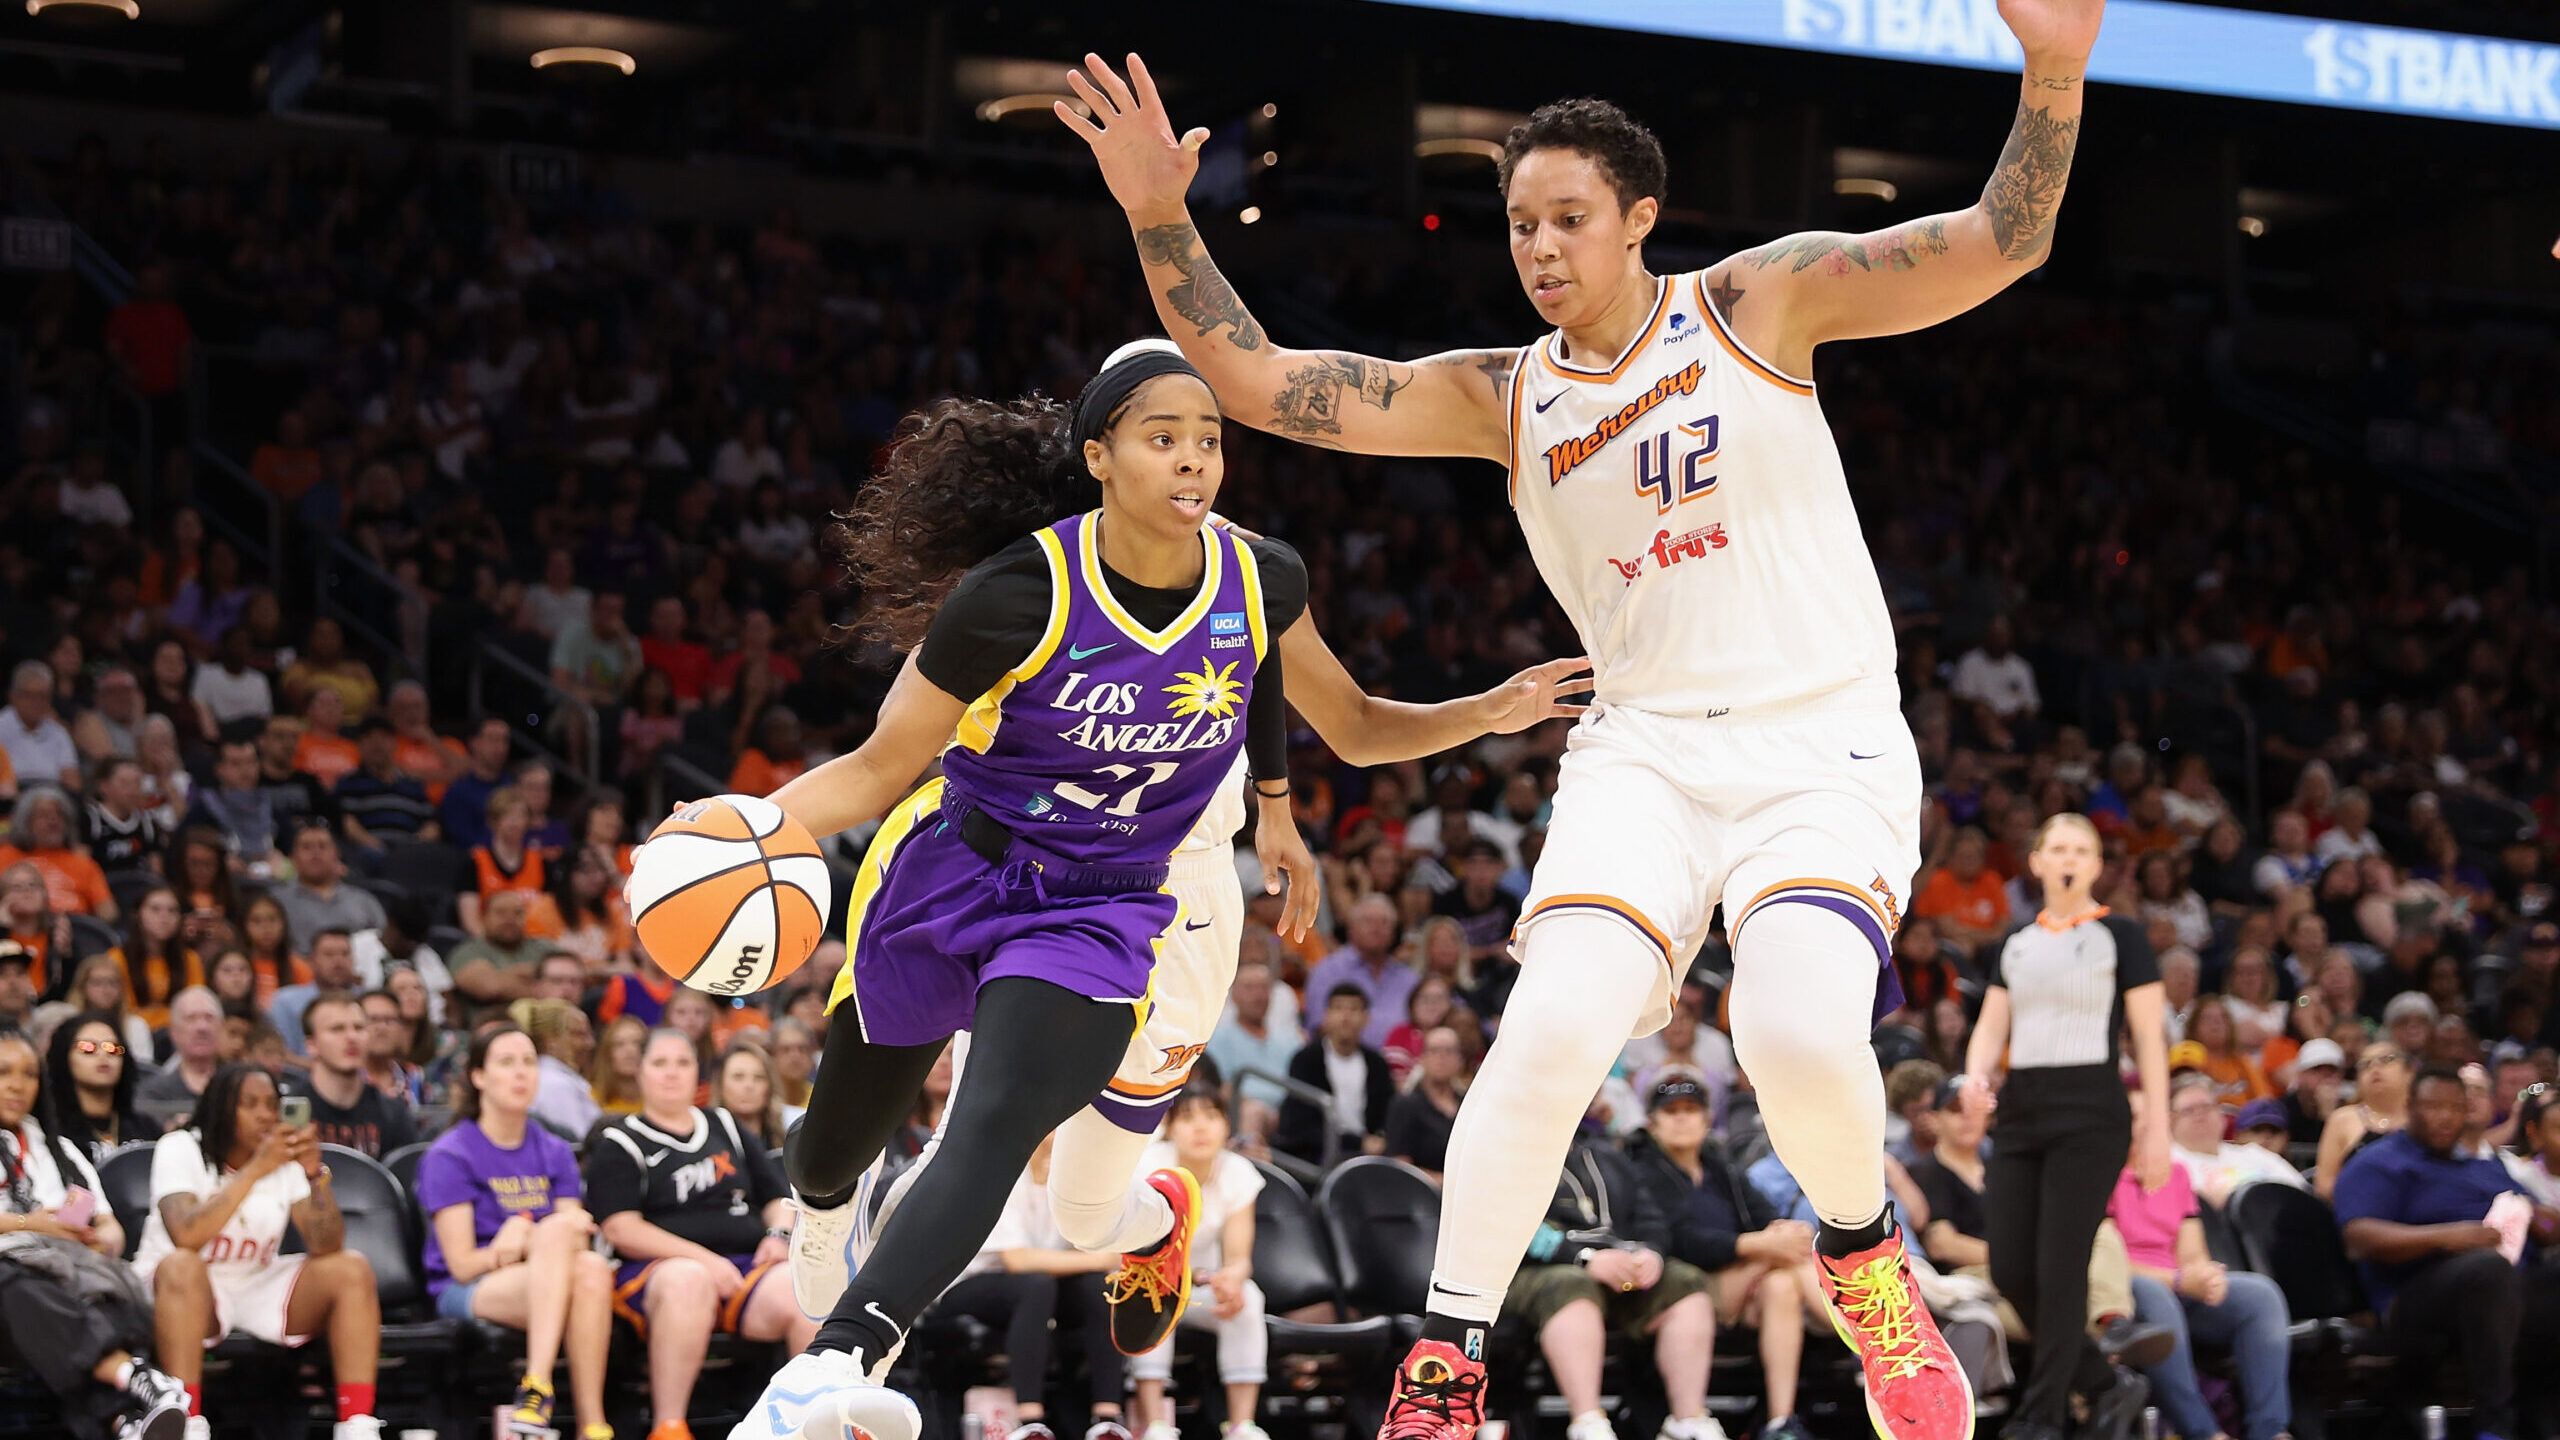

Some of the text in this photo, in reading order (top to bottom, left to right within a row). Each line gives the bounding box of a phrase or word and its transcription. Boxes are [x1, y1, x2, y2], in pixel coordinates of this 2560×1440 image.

[1785, 0, 2023, 57] 1STBAN
[2303, 25, 2560, 120] 1STBANK
[1663, 323, 1700, 347] PayPal
[1542, 359, 1706, 486] Mercury
[1635, 414, 1720, 515] 42
[1648, 529, 1728, 569] fry's
[1214, 617, 1241, 630] UCLA
[1050, 672, 1142, 715] LOS
[1057, 714, 1240, 753] ANGELES
[707, 944, 764, 994] ilson
